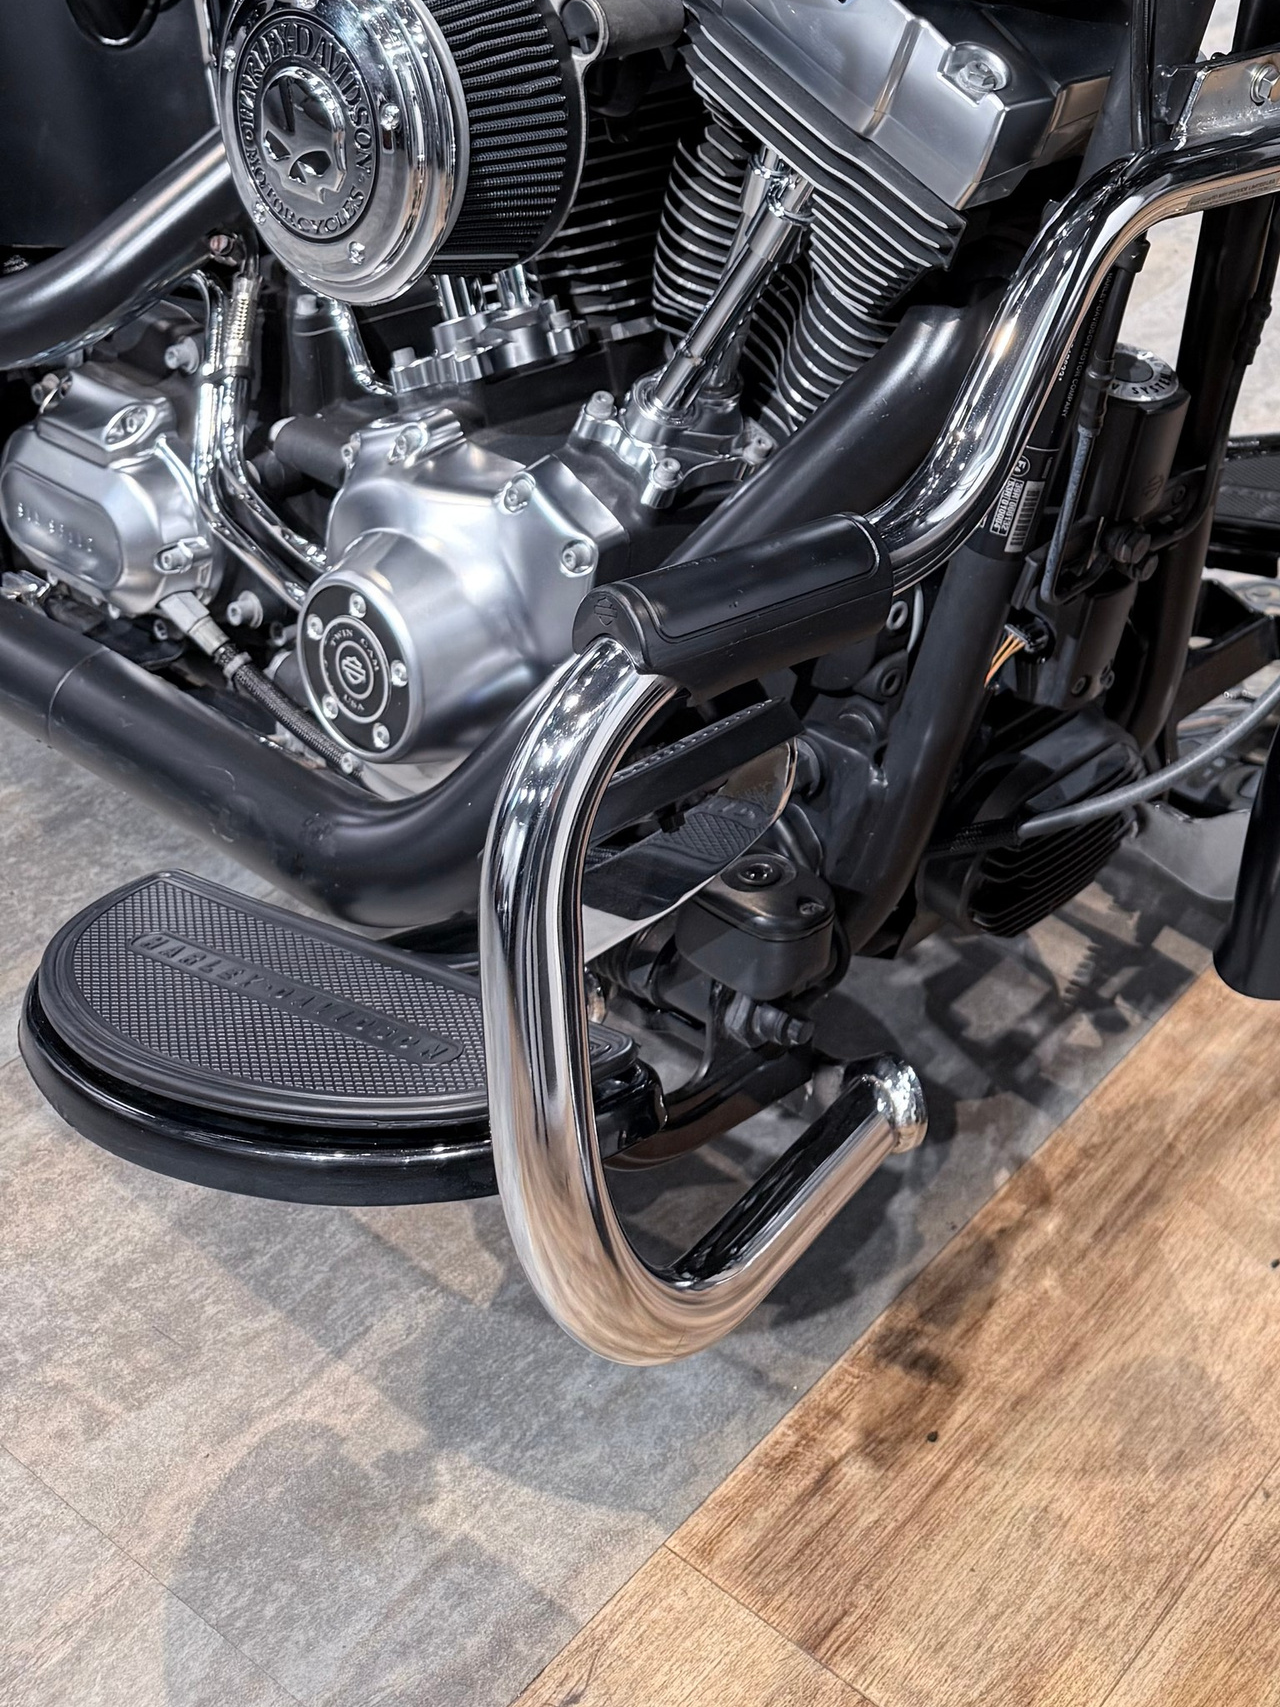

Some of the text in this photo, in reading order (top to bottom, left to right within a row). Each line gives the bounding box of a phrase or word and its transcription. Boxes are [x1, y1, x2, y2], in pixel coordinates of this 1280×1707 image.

[246, 149, 365, 234] MOTORCYCLES
[329, 629, 380, 672] TWIN CAM
[342, 694, 365, 712] USA
[140, 935, 449, 1062] HARLEY-DAVIDSON
